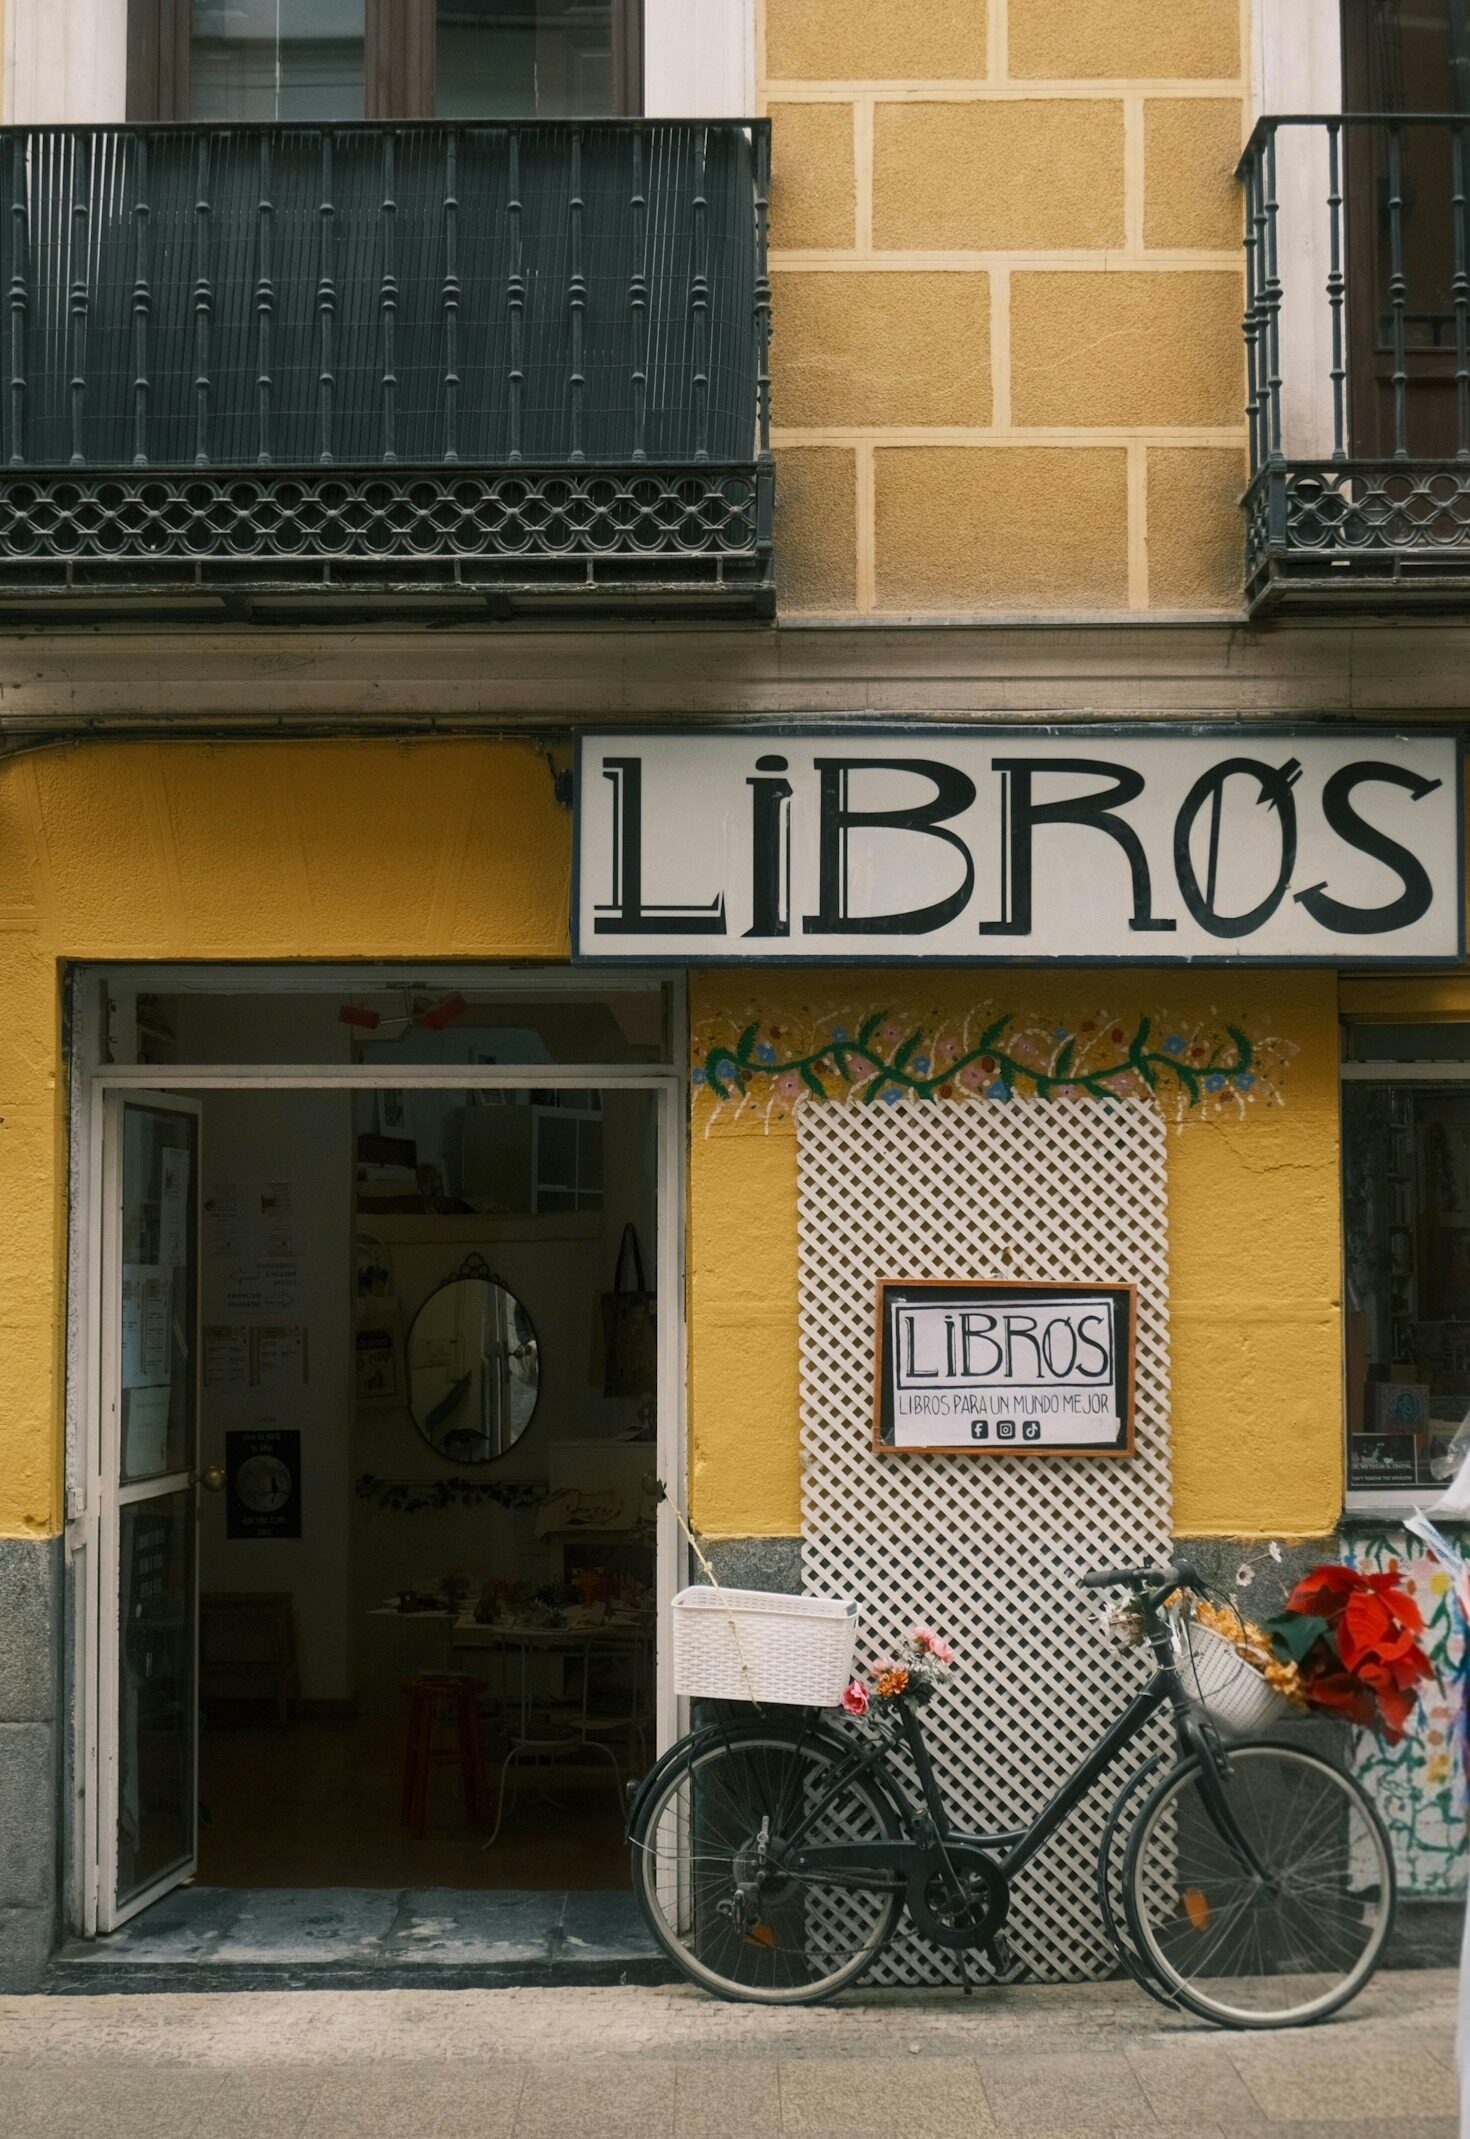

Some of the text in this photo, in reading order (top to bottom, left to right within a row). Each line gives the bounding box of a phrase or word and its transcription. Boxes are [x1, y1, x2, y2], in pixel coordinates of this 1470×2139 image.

[899, 1393, 1109, 1415] LIBROS PARA UN MUNDO MEJOR
